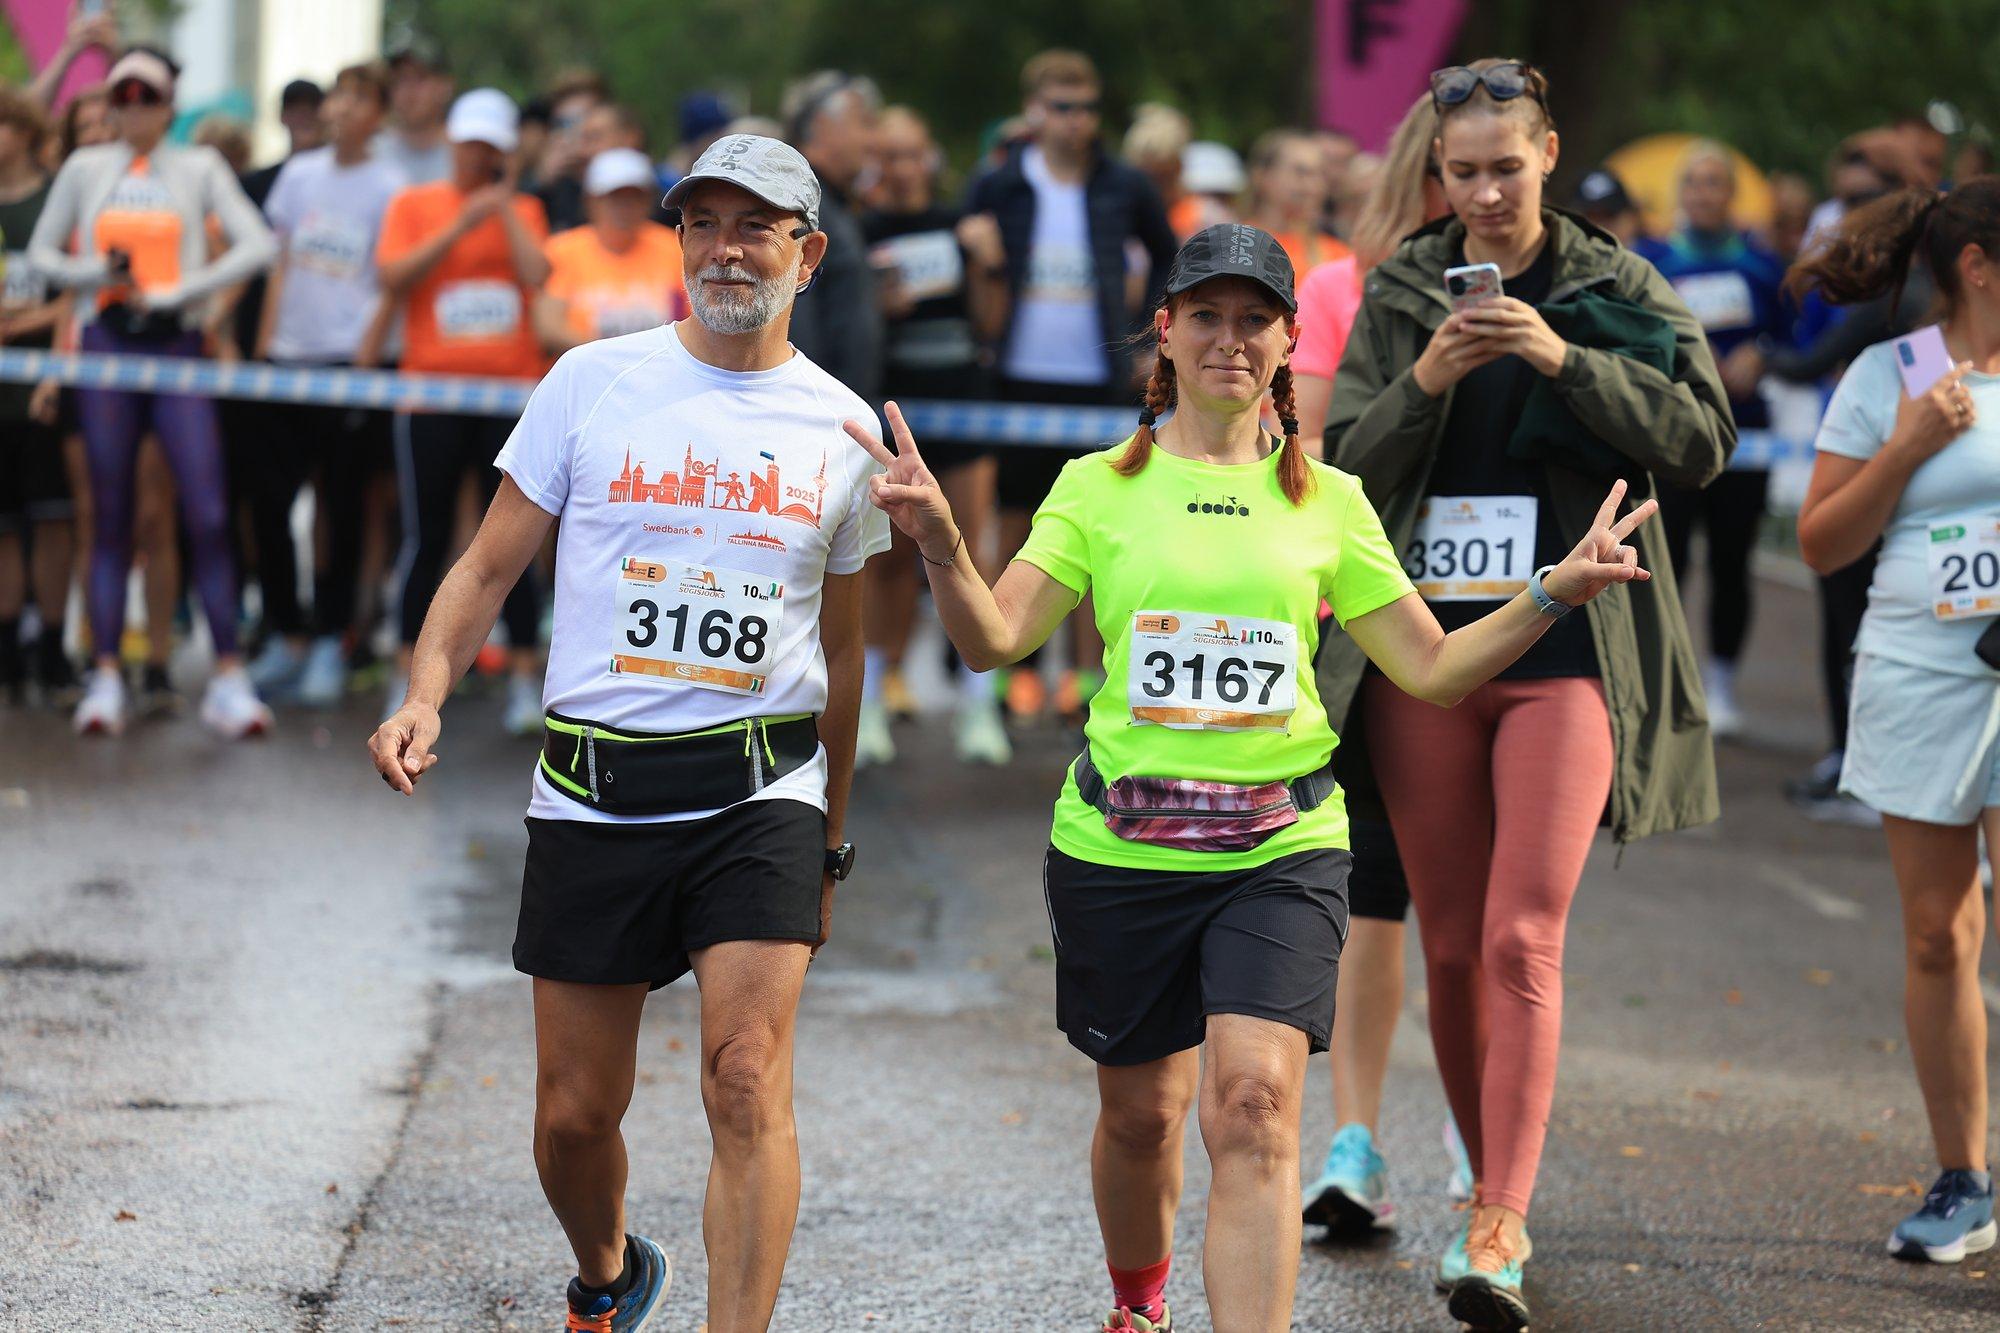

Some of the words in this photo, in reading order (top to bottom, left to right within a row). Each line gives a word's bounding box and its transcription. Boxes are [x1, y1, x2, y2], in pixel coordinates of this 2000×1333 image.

[786, 486, 815, 503] 2025
[1187, 493, 1249, 517] diadora
[642, 523, 690, 536] Swedbank
[727, 538, 757, 548] TALLINNA
[758, 542, 787, 552] MARATON
[1406, 537, 1513, 579] 3301
[647, 566, 657, 579] E
[743, 584, 759, 598] 10
[759, 593, 769, 601] km
[626, 598, 768, 664] 3168
[1161, 619, 1170, 630] E
[1256, 630, 1273, 644] 10
[1273, 638, 1284, 646] km
[1142, 650, 1285, 706] 3167
